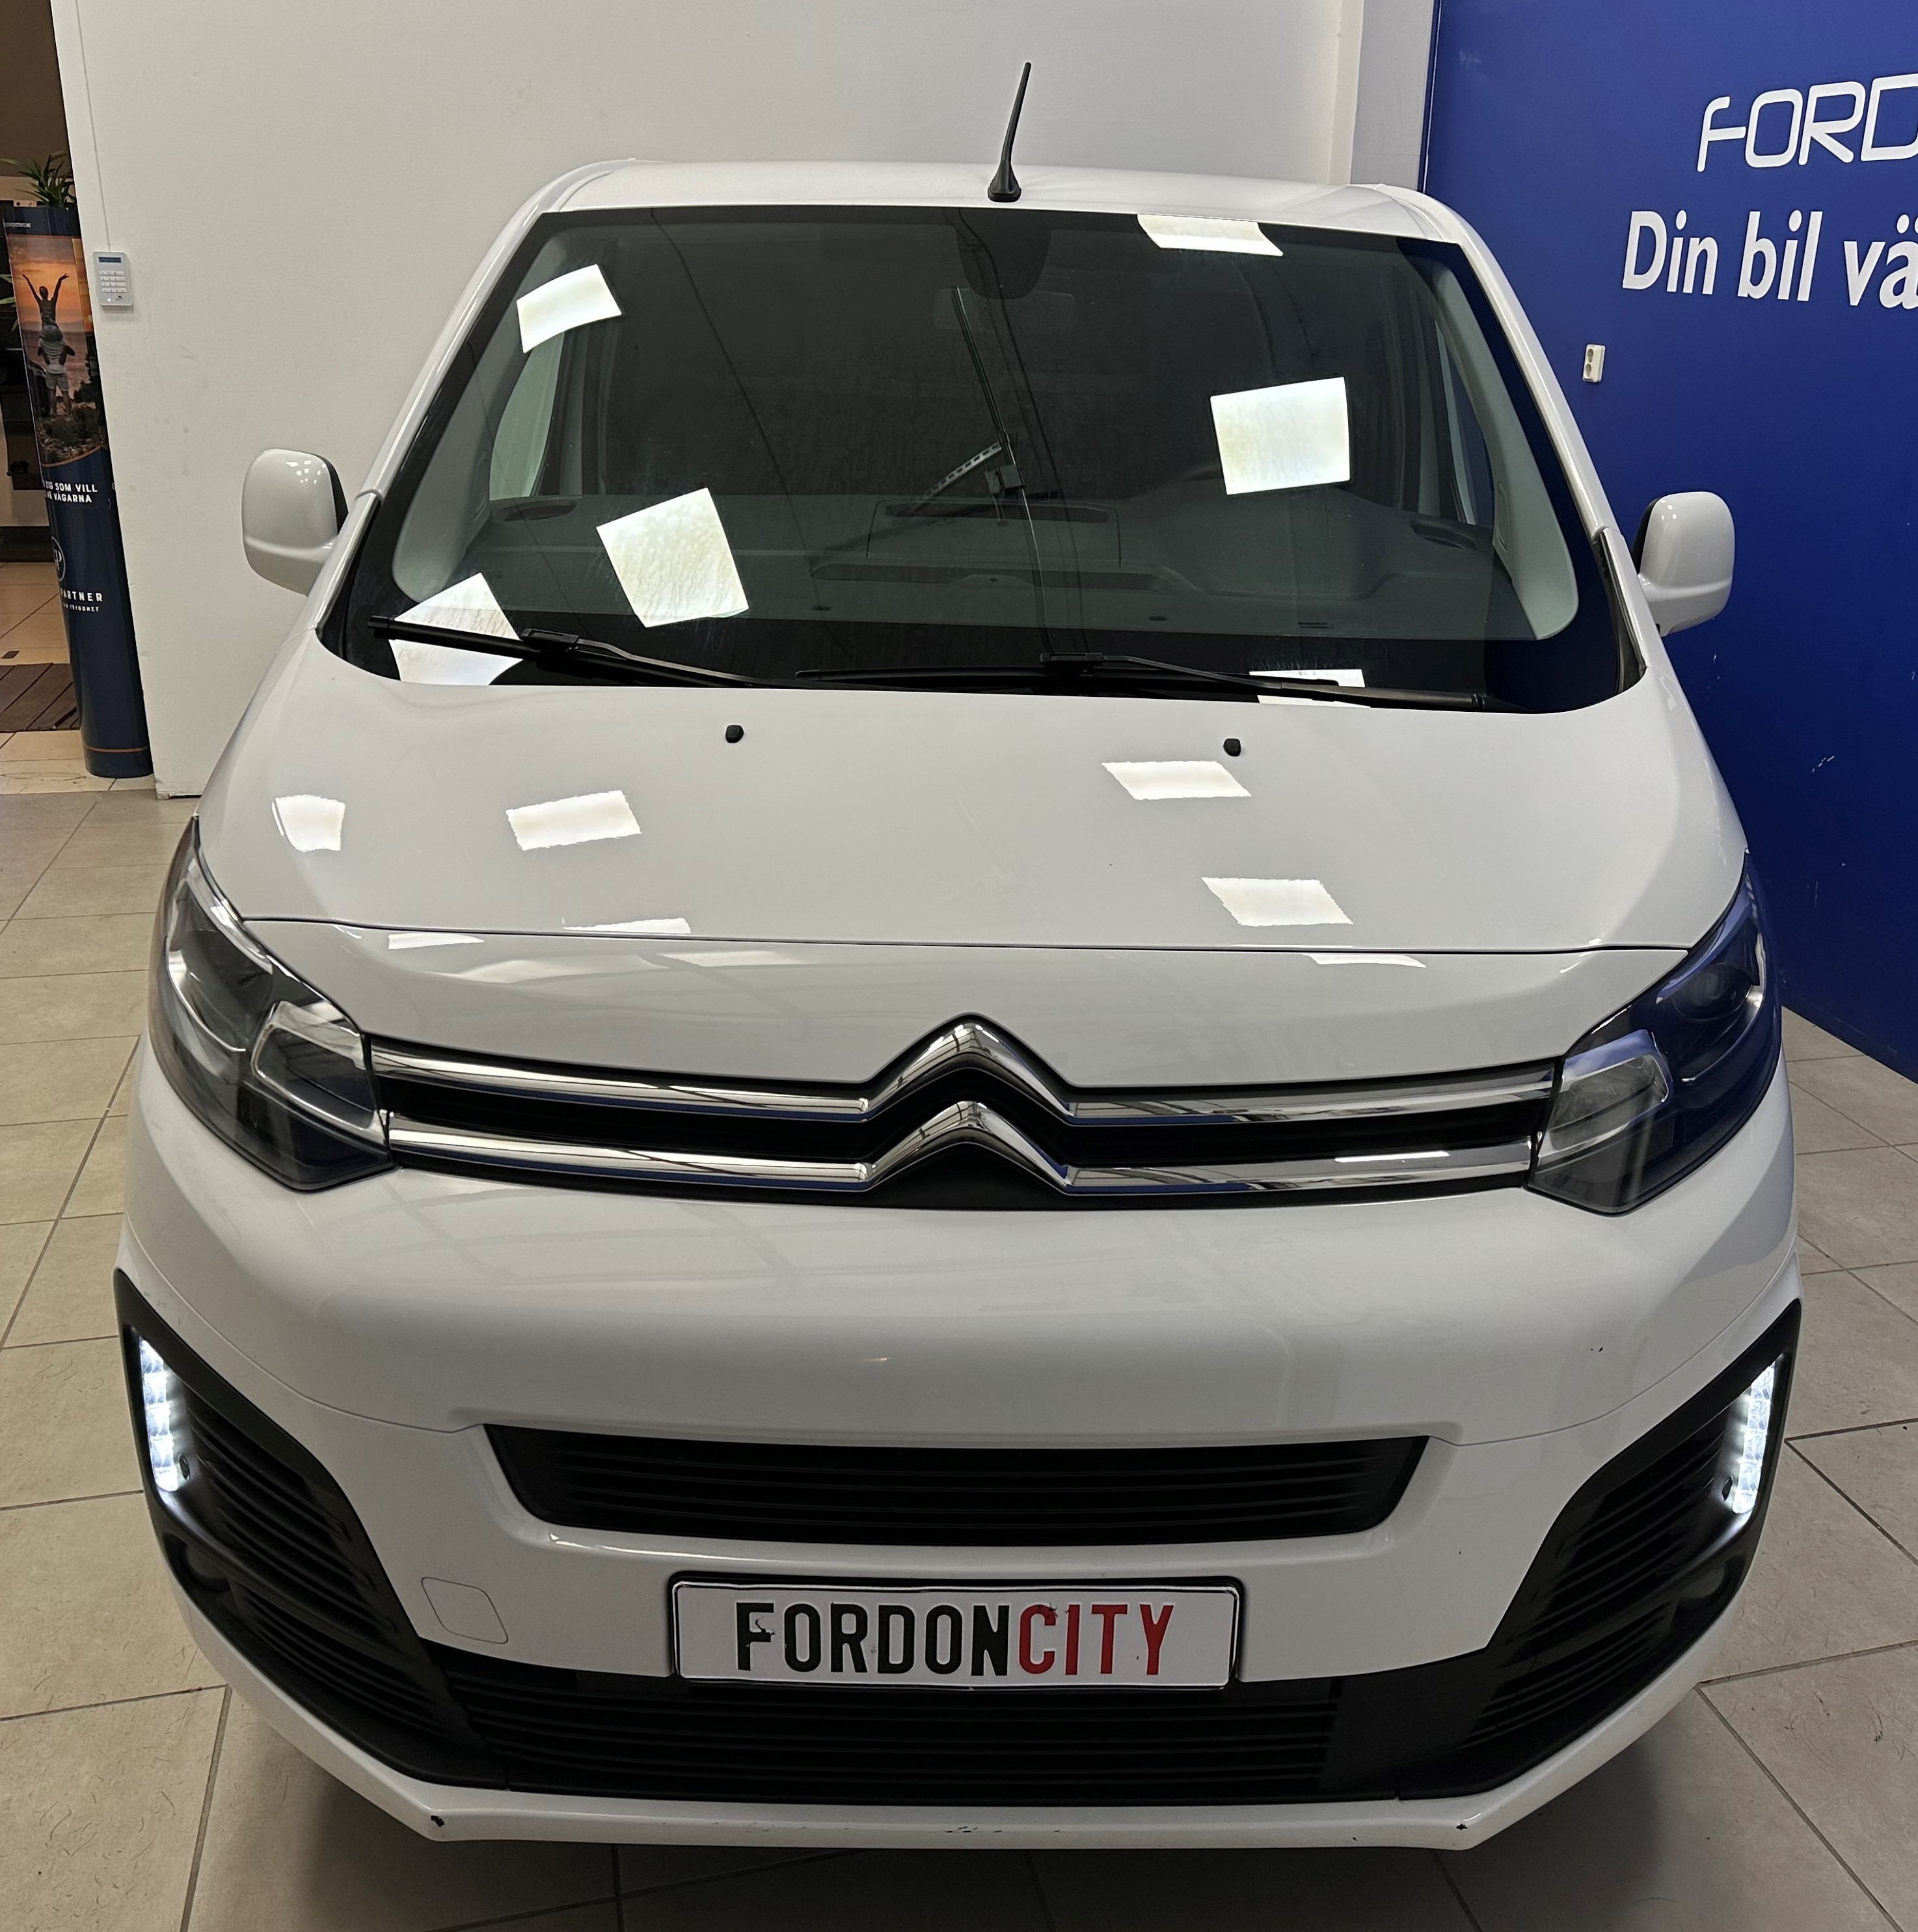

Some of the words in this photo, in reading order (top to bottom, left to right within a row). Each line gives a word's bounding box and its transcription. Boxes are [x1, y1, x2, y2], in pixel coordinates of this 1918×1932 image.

[1622, 210, 1718, 295] Din
[1737, 210, 1823, 302] bil
[55, 482, 72, 492] SOM
[75, 483, 98, 493] VILL
[735, 1601, 1175, 1677] FORDONCITY
